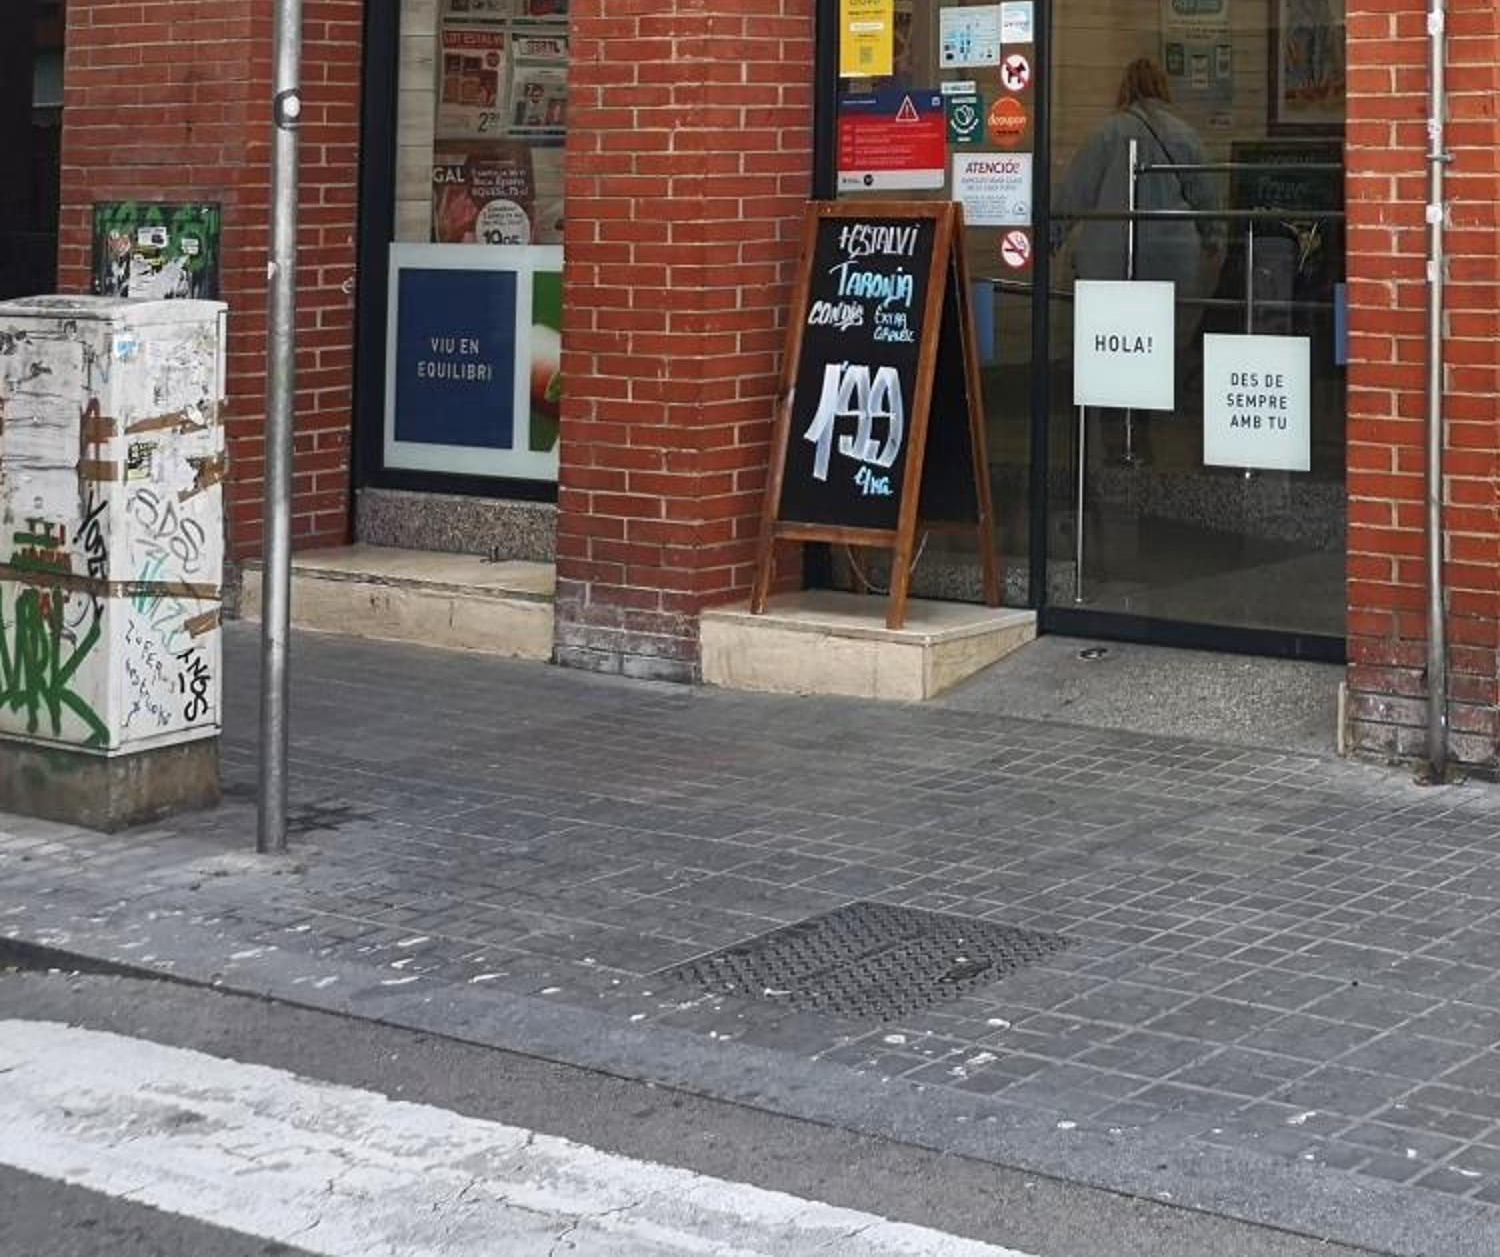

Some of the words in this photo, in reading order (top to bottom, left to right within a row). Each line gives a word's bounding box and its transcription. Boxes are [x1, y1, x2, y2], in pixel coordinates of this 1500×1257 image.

[431, 337, 456, 354] VIU
[459, 338, 480, 355] EN
[1095, 334, 1154, 354] HOLA!
[417, 360, 494, 381] EQUILIBRI
[1230, 372, 1259, 388] DES
[1264, 374, 1284, 389] DE
[1226, 393, 1288, 411] SEMPRE
[1229, 414, 1262, 430] AMB
[1268, 415, 1288, 431] TU
